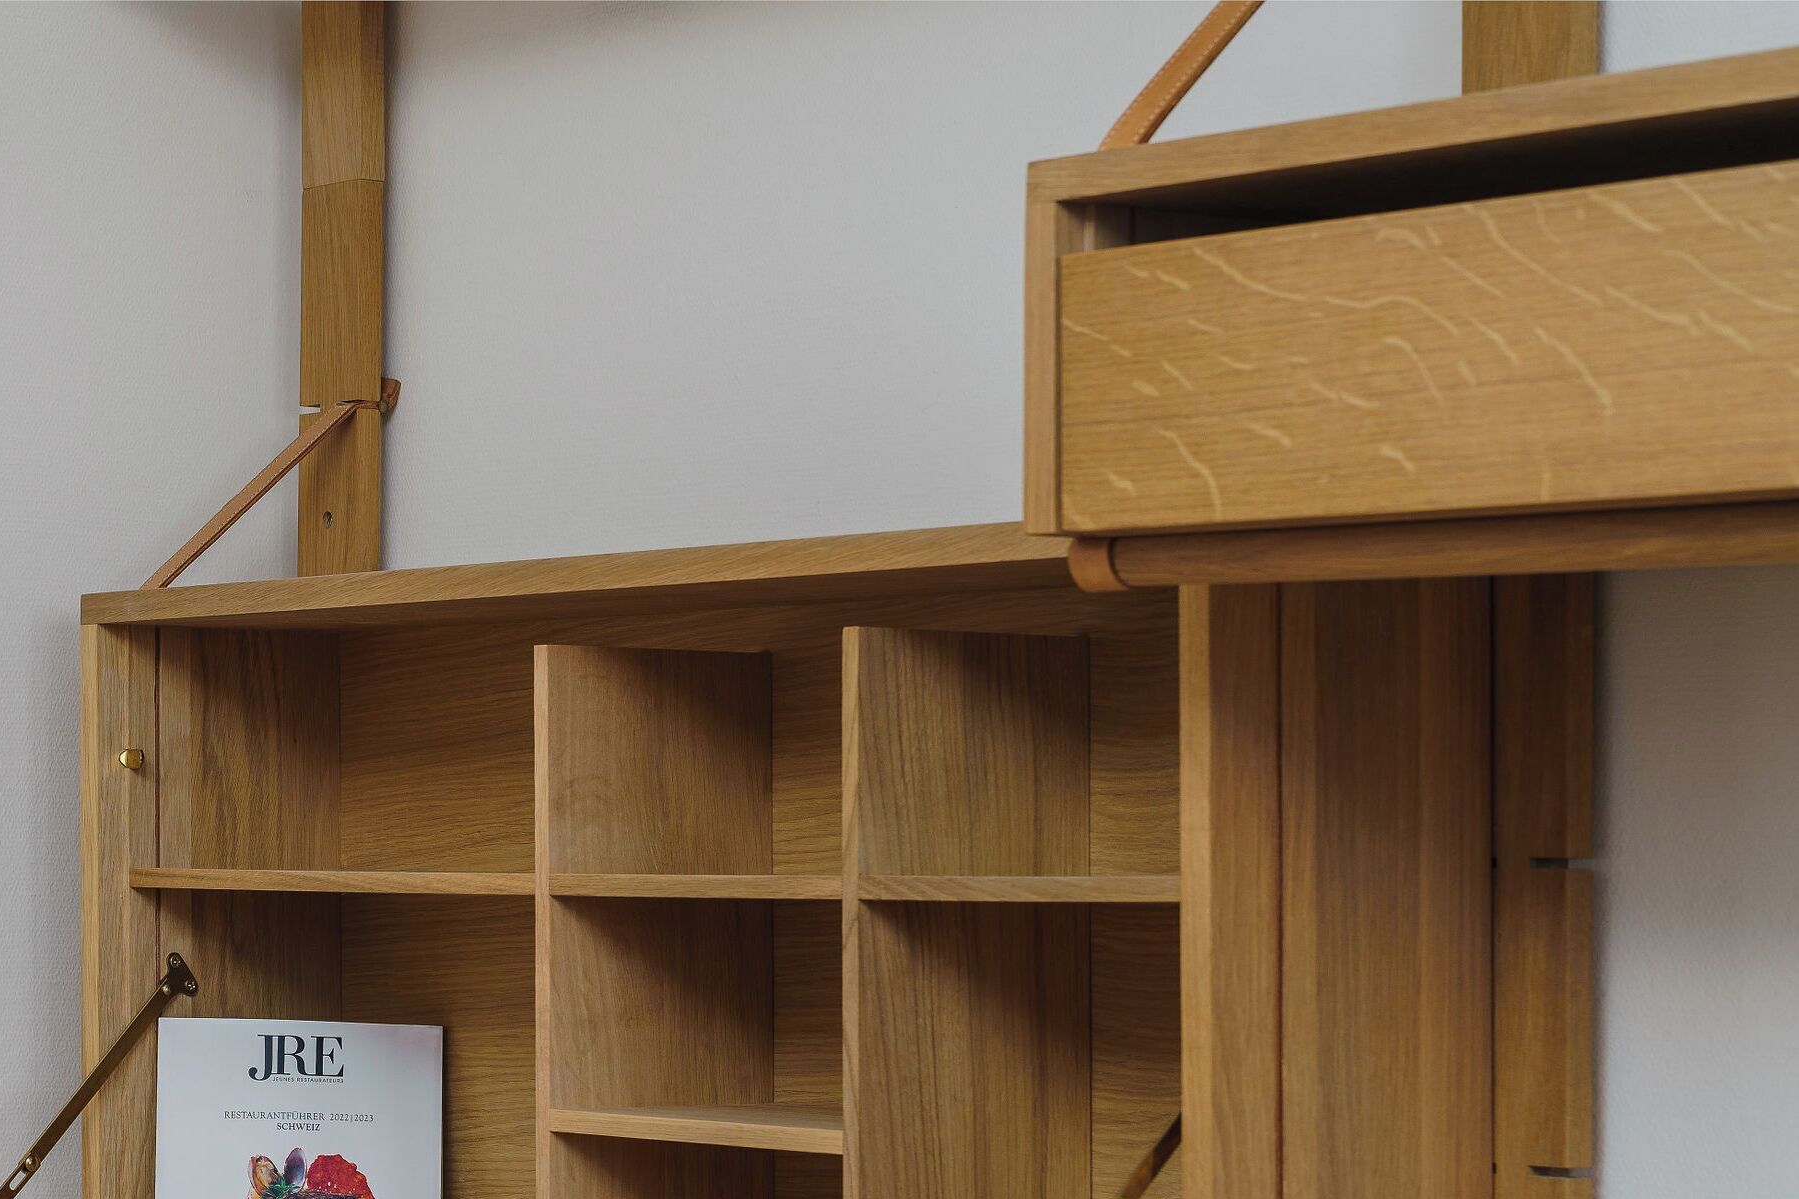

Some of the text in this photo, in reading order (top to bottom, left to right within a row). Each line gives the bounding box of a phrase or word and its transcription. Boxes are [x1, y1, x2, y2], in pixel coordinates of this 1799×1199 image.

[248, 1034, 344, 1081] JRE
[224, 1110, 325, 1121] RESTAURANTFÜHRER
[276, 1122, 321, 1132] SCHWEIZ
